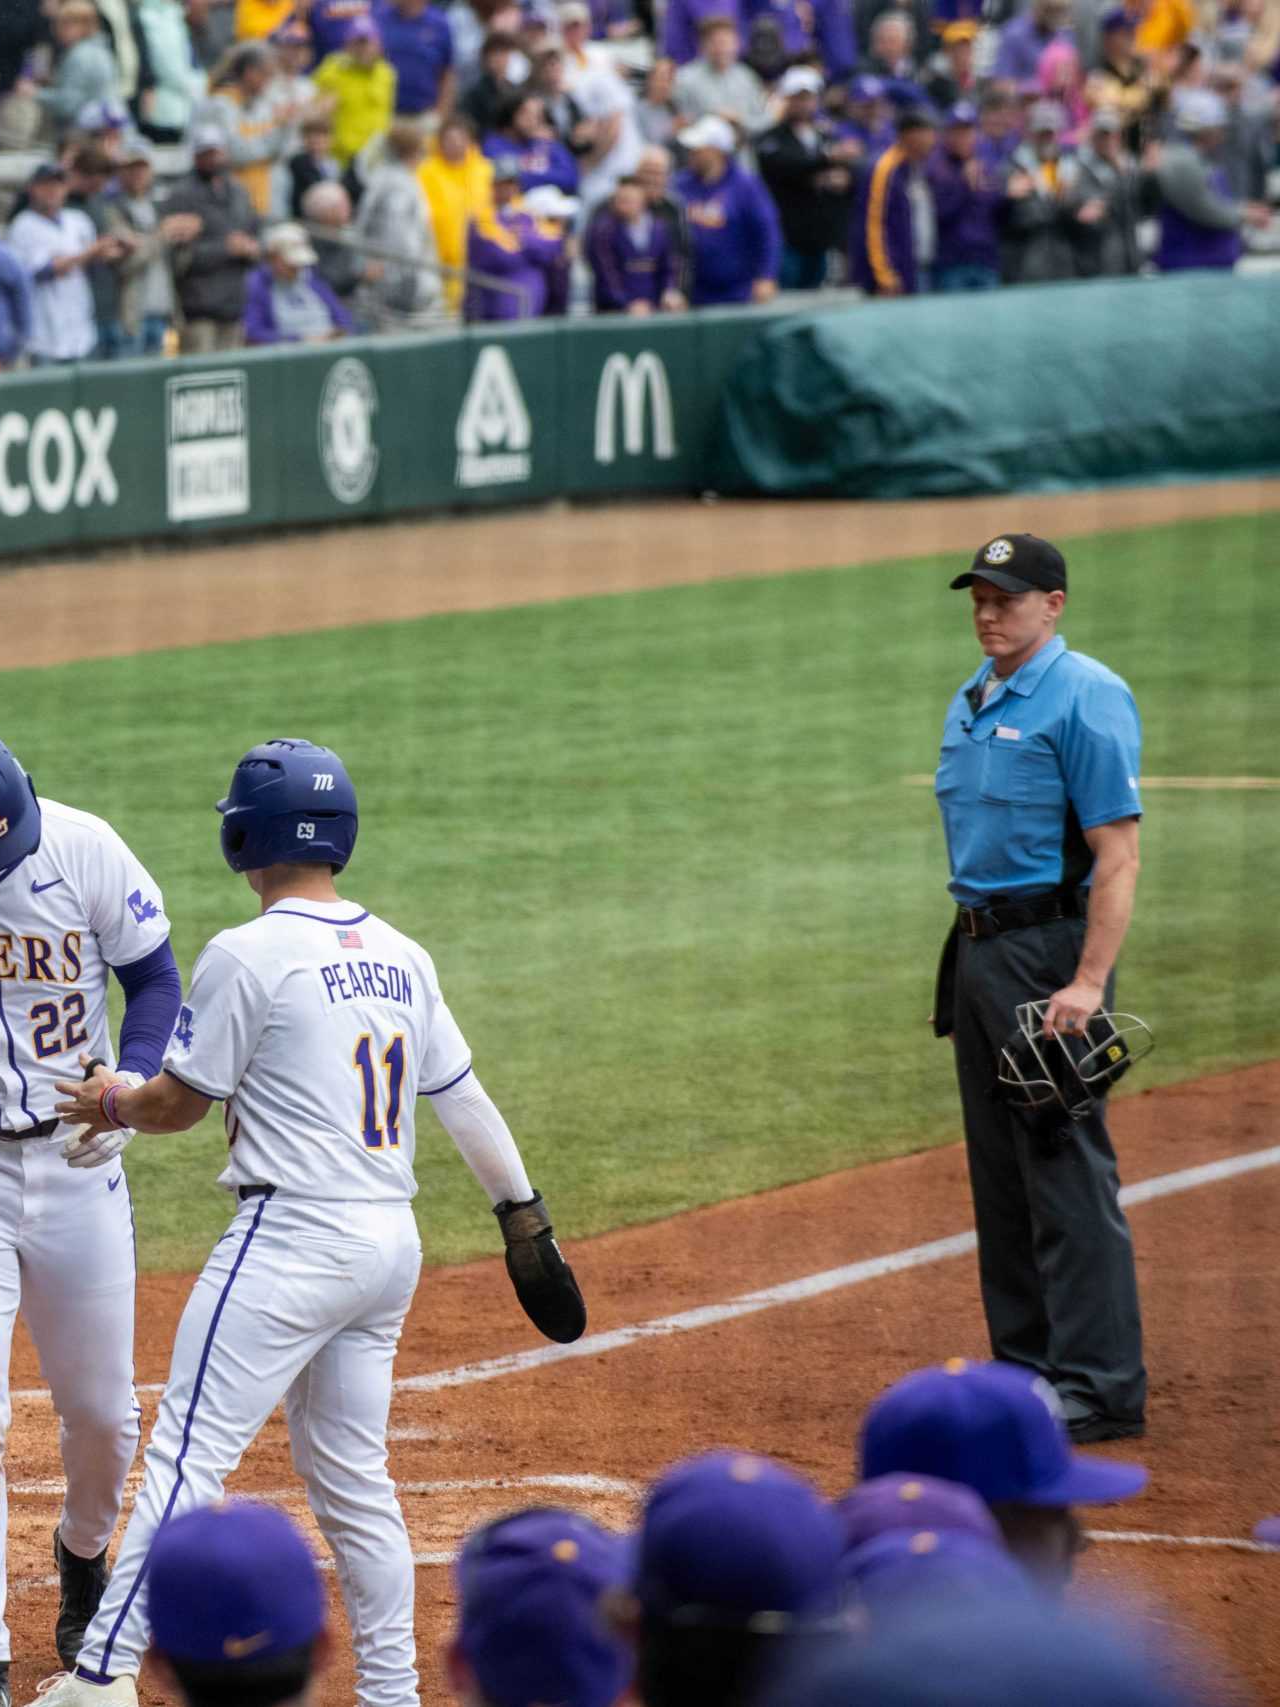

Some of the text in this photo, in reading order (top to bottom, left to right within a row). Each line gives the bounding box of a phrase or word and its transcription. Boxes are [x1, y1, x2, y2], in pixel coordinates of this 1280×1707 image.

[320, 961, 413, 1008] PEARSON
[29, 992, 89, 1061] 22
[352, 1031, 408, 1152] 11
